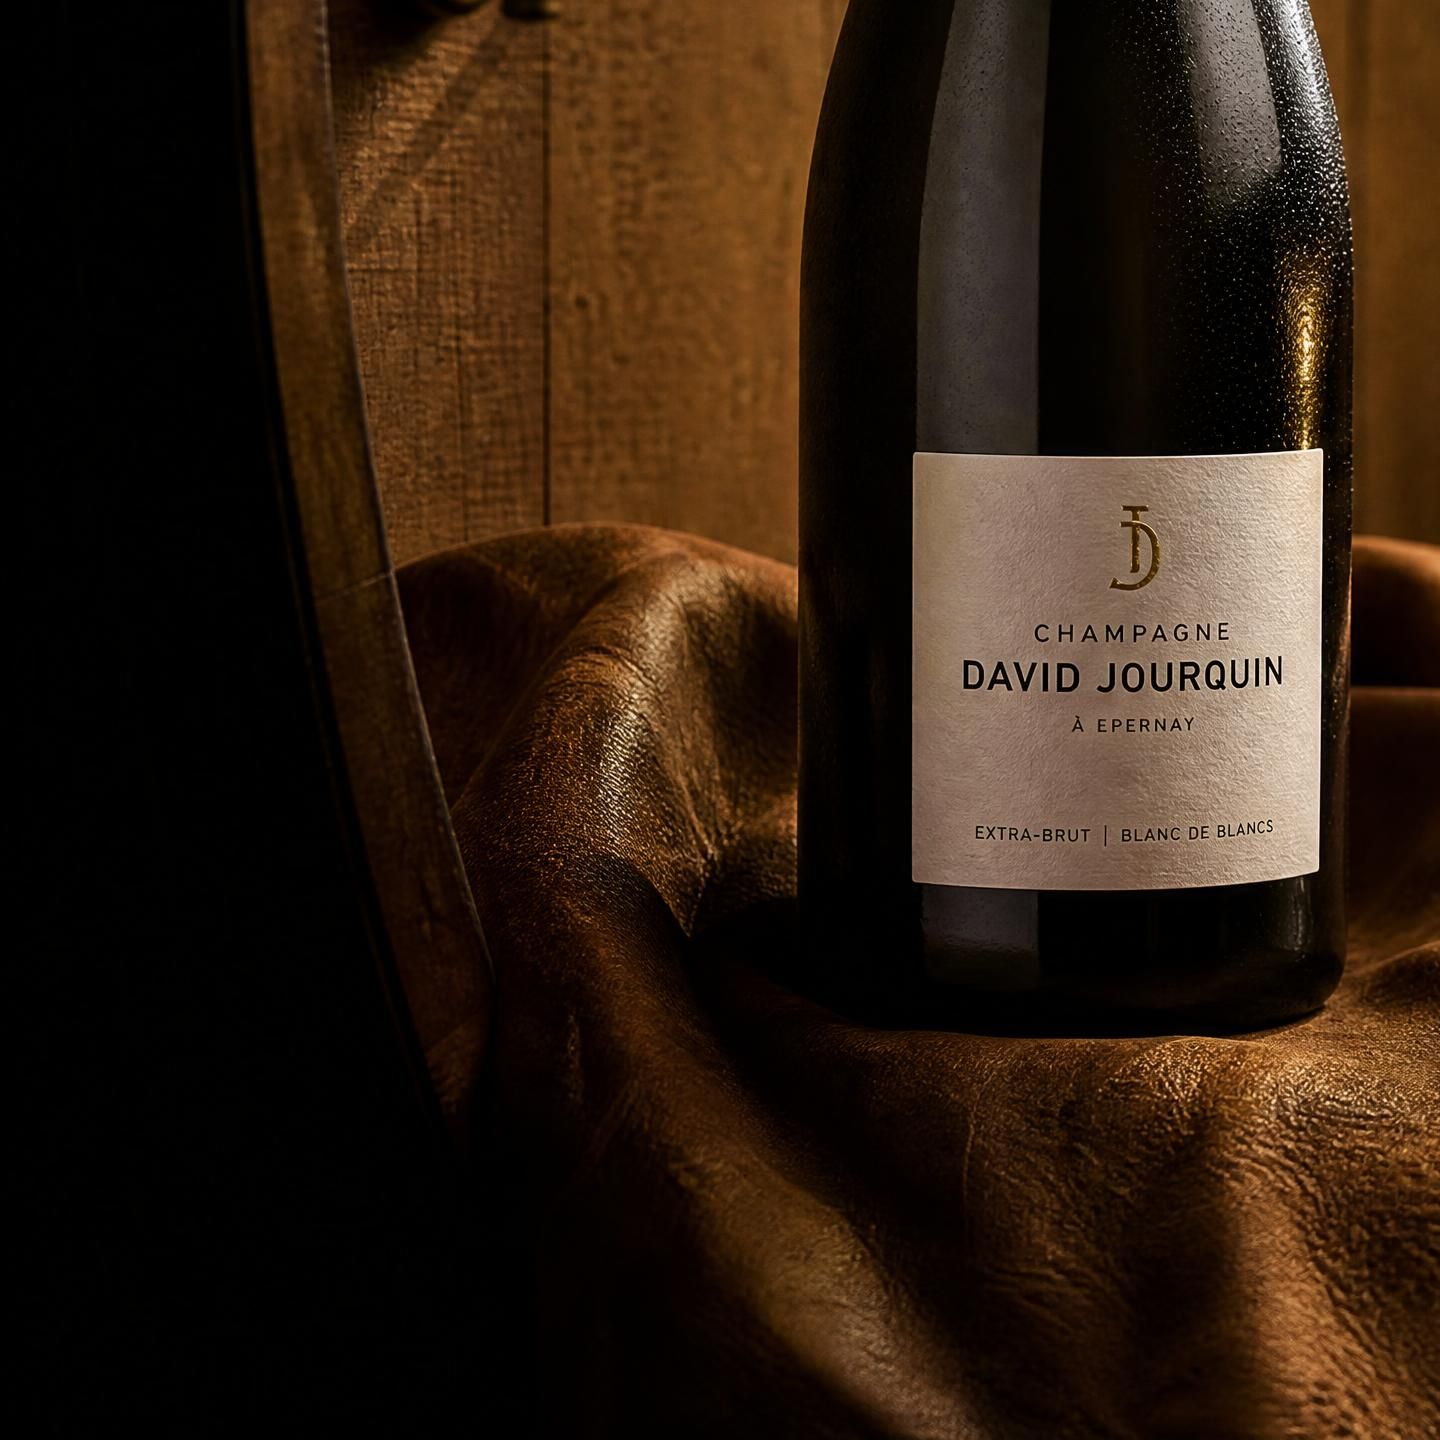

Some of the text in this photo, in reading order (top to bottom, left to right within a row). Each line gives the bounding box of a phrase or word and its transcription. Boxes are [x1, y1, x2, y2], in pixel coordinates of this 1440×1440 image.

[1033, 622, 1230, 643] CHAMPAGNE
[962, 655, 1283, 693] DAVID JOURQUIN
[1071, 715, 1195, 733] À EPERNAY
[974, 819, 1274, 843] EXTRA-BRUT BLANC DE BLANCS
